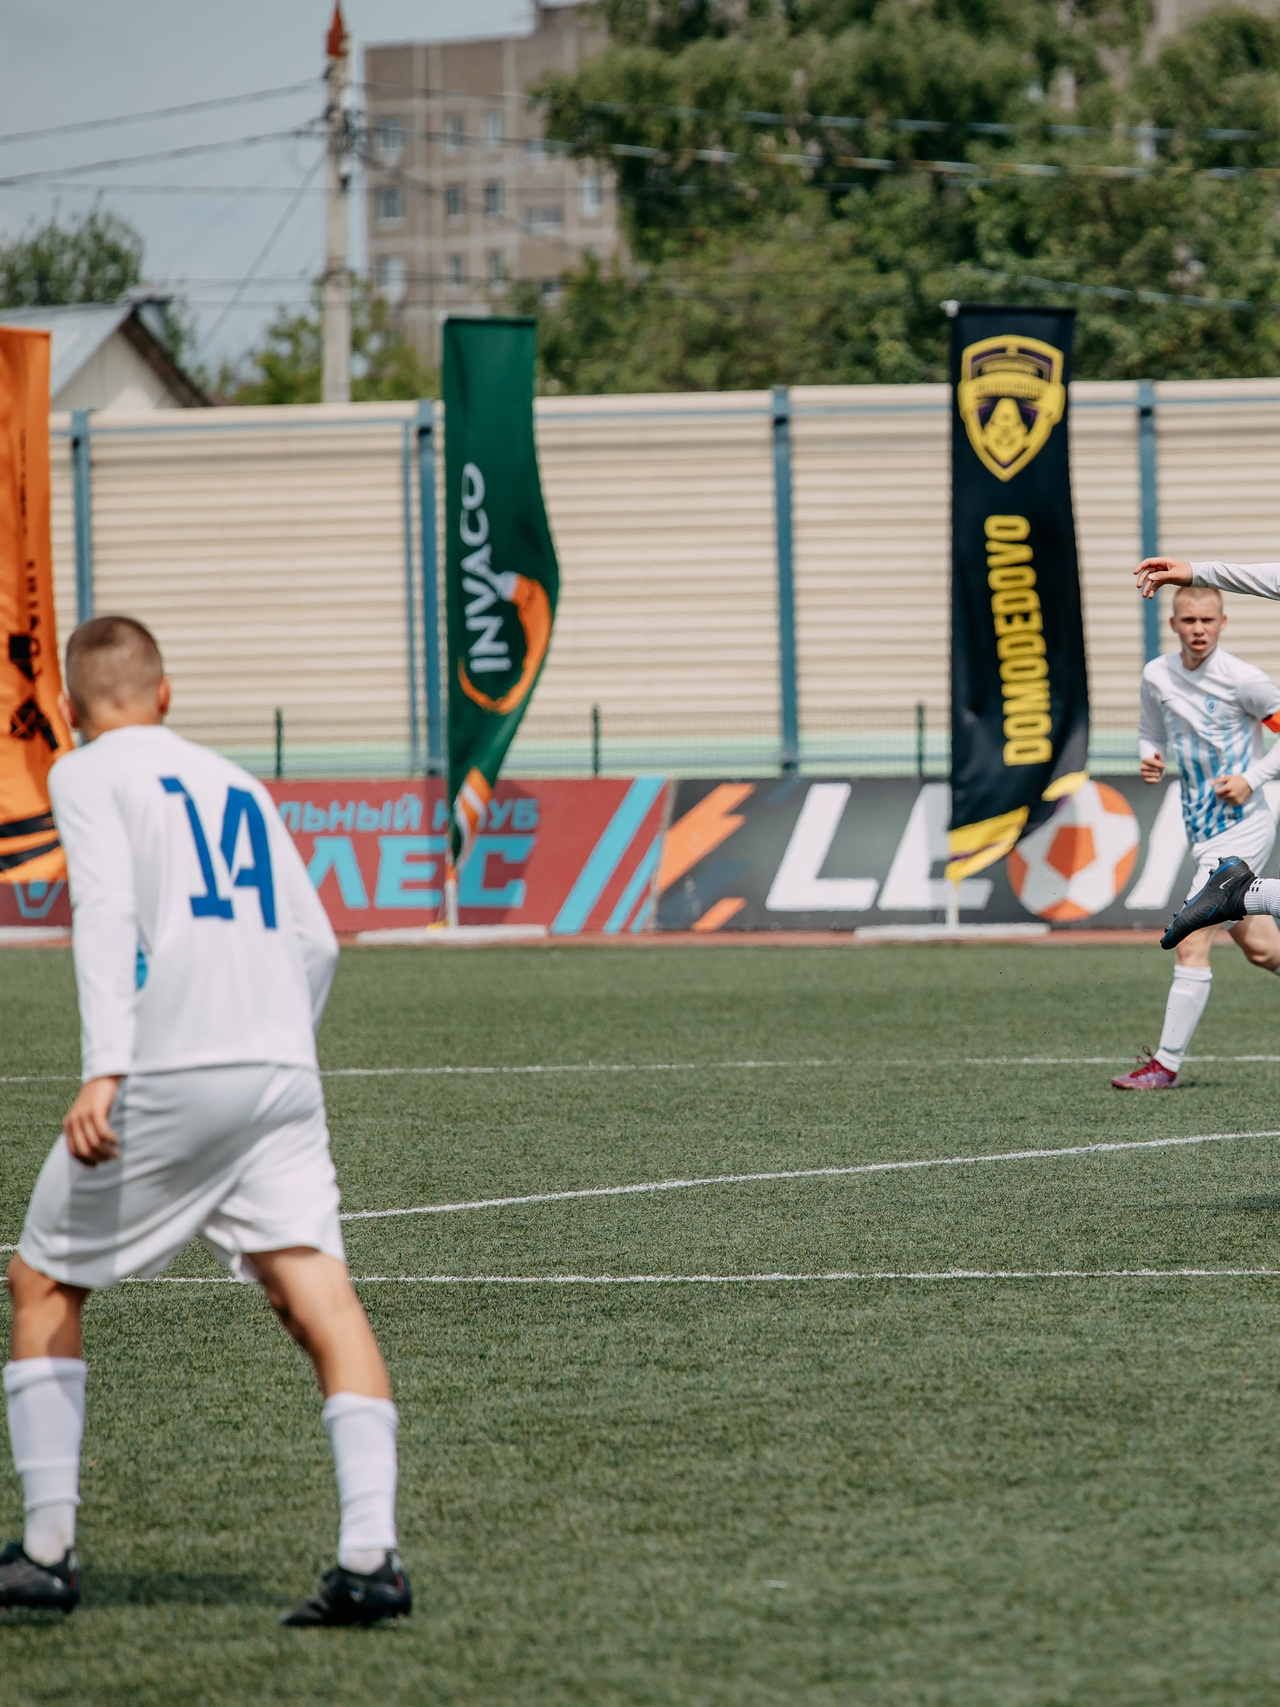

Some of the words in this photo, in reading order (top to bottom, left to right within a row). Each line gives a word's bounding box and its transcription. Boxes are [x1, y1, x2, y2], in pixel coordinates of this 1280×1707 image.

[459, 462, 513, 673] INVACO
[984, 514, 1052, 766] DOMODEDOVO
[159, 777, 278, 930] 14
[279, 793, 422, 831] ЛЬНЫЙ
[307, 834, 535, 909] ЛЕС
